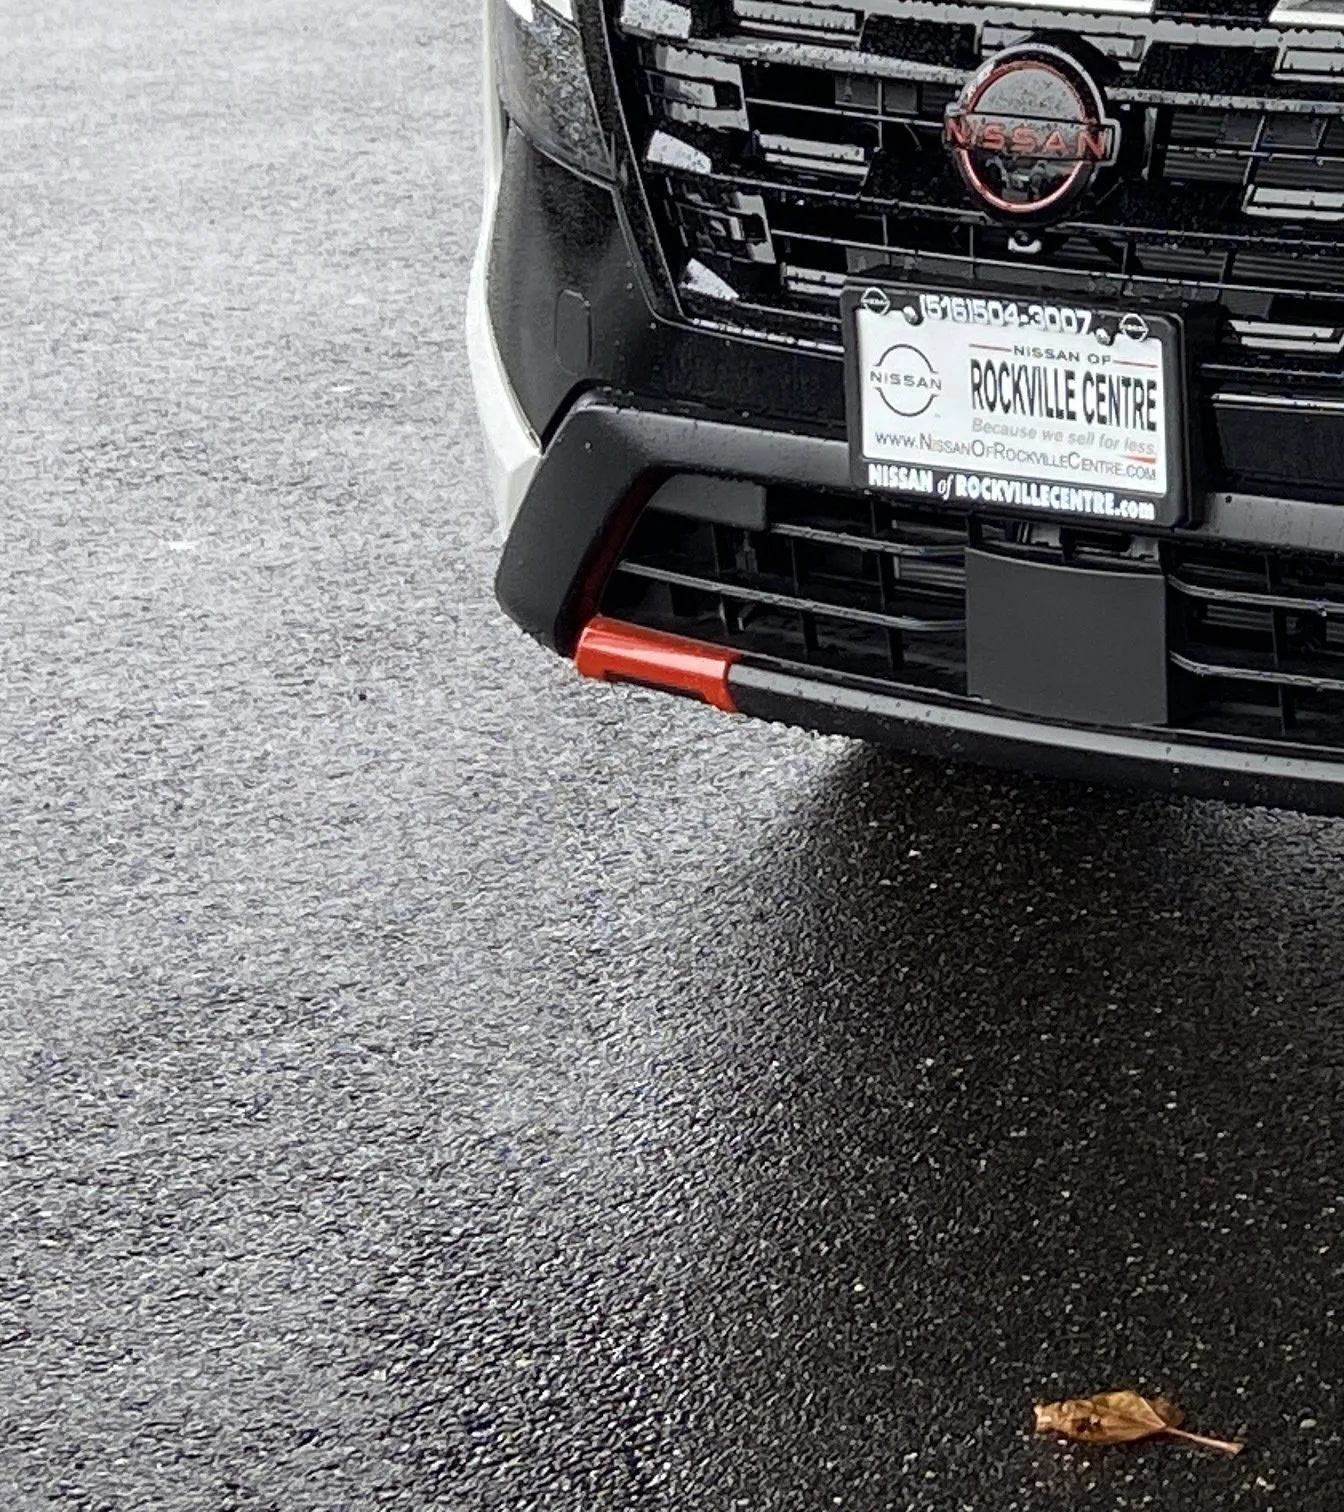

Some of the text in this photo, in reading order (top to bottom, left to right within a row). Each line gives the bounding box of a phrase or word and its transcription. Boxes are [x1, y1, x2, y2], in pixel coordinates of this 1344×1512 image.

[945, 117, 1112, 159] NISSAN
[1013, 345, 1112, 365] NISSAN OF
[870, 371, 942, 390] NISSAN
[970, 358, 1157, 432] ROCKVILLE CENTRE
[972, 417, 1037, 437] Because
[1042, 430, 1063, 443] we
[1068, 431, 1095, 445] sell
[1099, 433, 1120, 450] for
[868, 463, 1155, 520] NISSAN of ROCKVILLECENTRE.com
